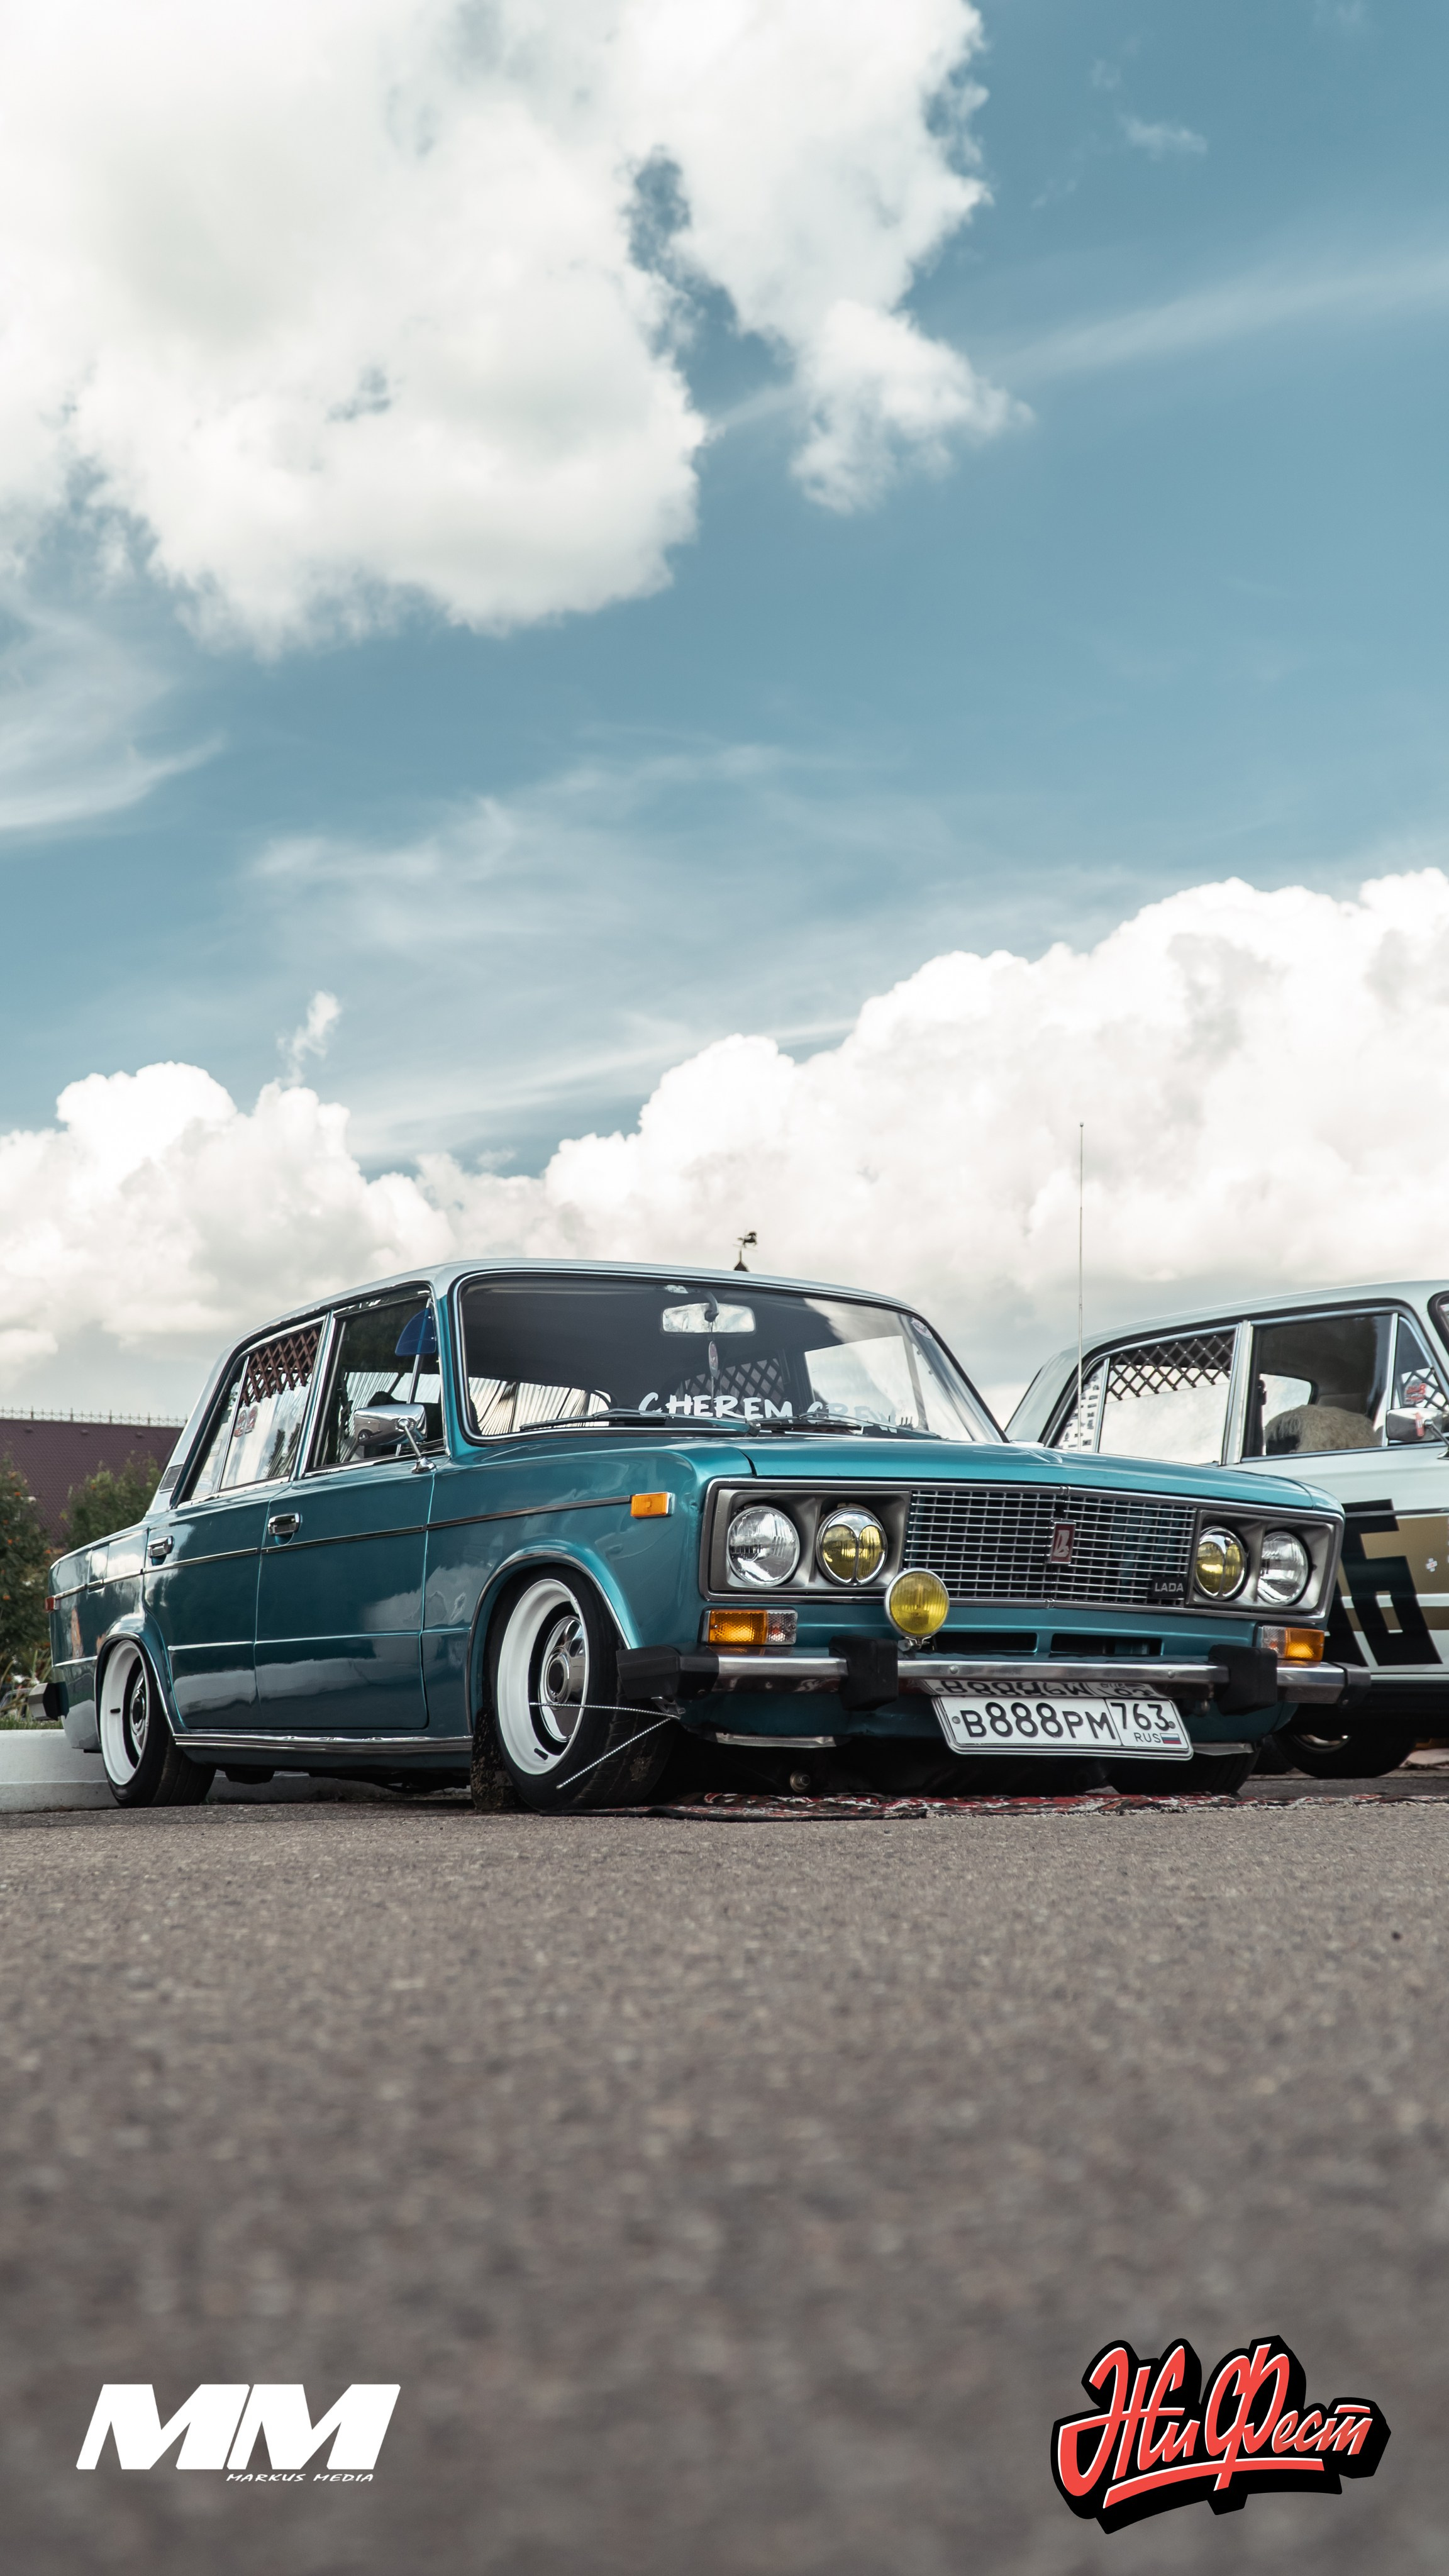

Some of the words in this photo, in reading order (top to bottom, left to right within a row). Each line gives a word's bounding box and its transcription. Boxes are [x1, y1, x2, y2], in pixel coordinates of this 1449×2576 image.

[638, 1392, 793, 1424] CHEREM
[1155, 1582, 1184, 1592] LADA
[1109, 1702, 1172, 1731] 763
[1134, 1732, 1162, 1743] RUS
